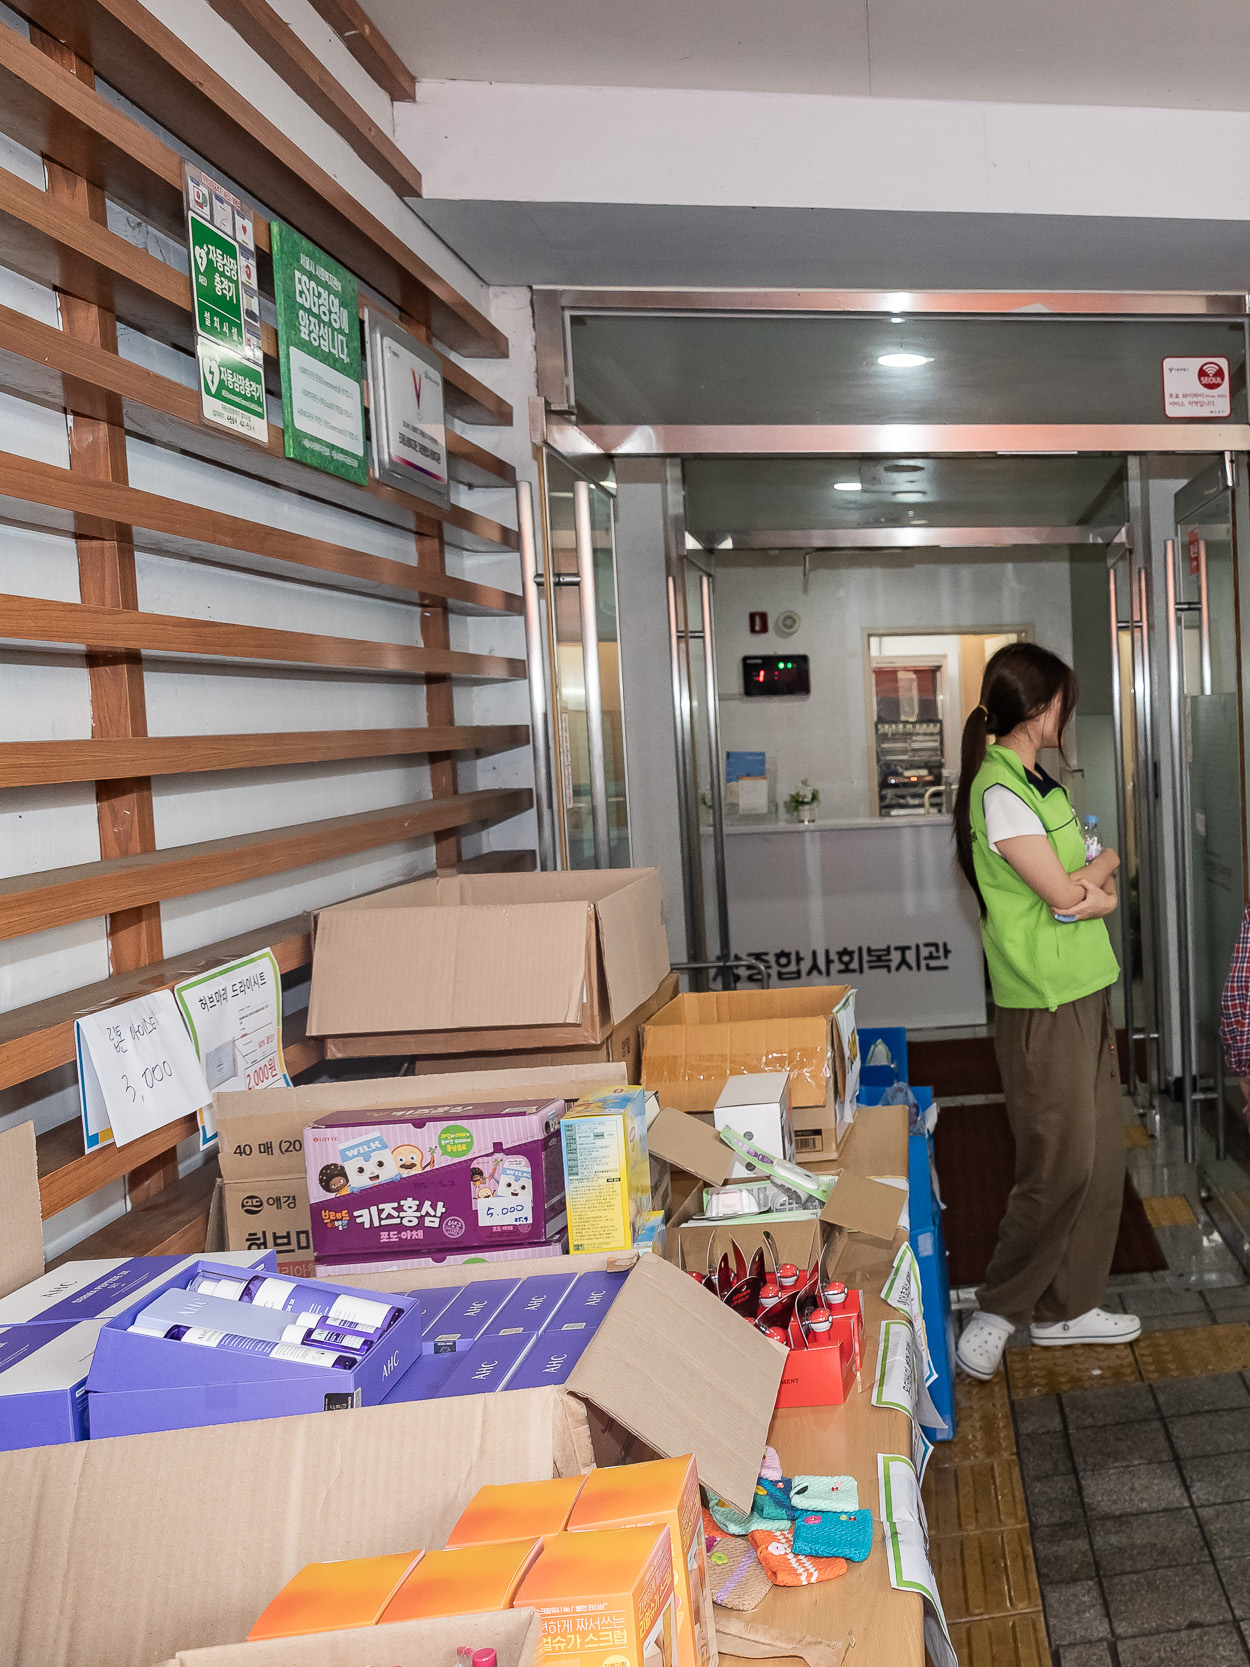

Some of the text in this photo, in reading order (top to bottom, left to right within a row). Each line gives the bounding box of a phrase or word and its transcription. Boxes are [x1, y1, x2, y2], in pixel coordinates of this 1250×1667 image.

[208, 244, 238, 281] 자동심장
[214, 272, 237, 304] 충격기
[294, 269, 349, 334] ESG경영에
[220, 366, 263, 403] 자동심장충격기
[1200, 376, 1222, 384] SEOUL
[121, 1060, 173, 1103] 3,000
[246, 1055, 279, 1091] 2,000원
[233, 1144, 253, 1157] 40
[344, 1138, 383, 1158] WILK
[266, 1195, 297, 1210] 애경
[353, 1197, 446, 1229] 키즈홍삼
[178, 1298, 209, 1318] AHC
[524, 1294, 547, 1311] AHC
[584, 1290, 606, 1306] AHC
[464, 1300, 488, 1317] AHC
[381, 1350, 400, 1382] AHC
[471, 1360, 499, 1380] AHC
[542, 1353, 568, 1374] AHC
[584, 1629, 628, 1649] 스크럽
